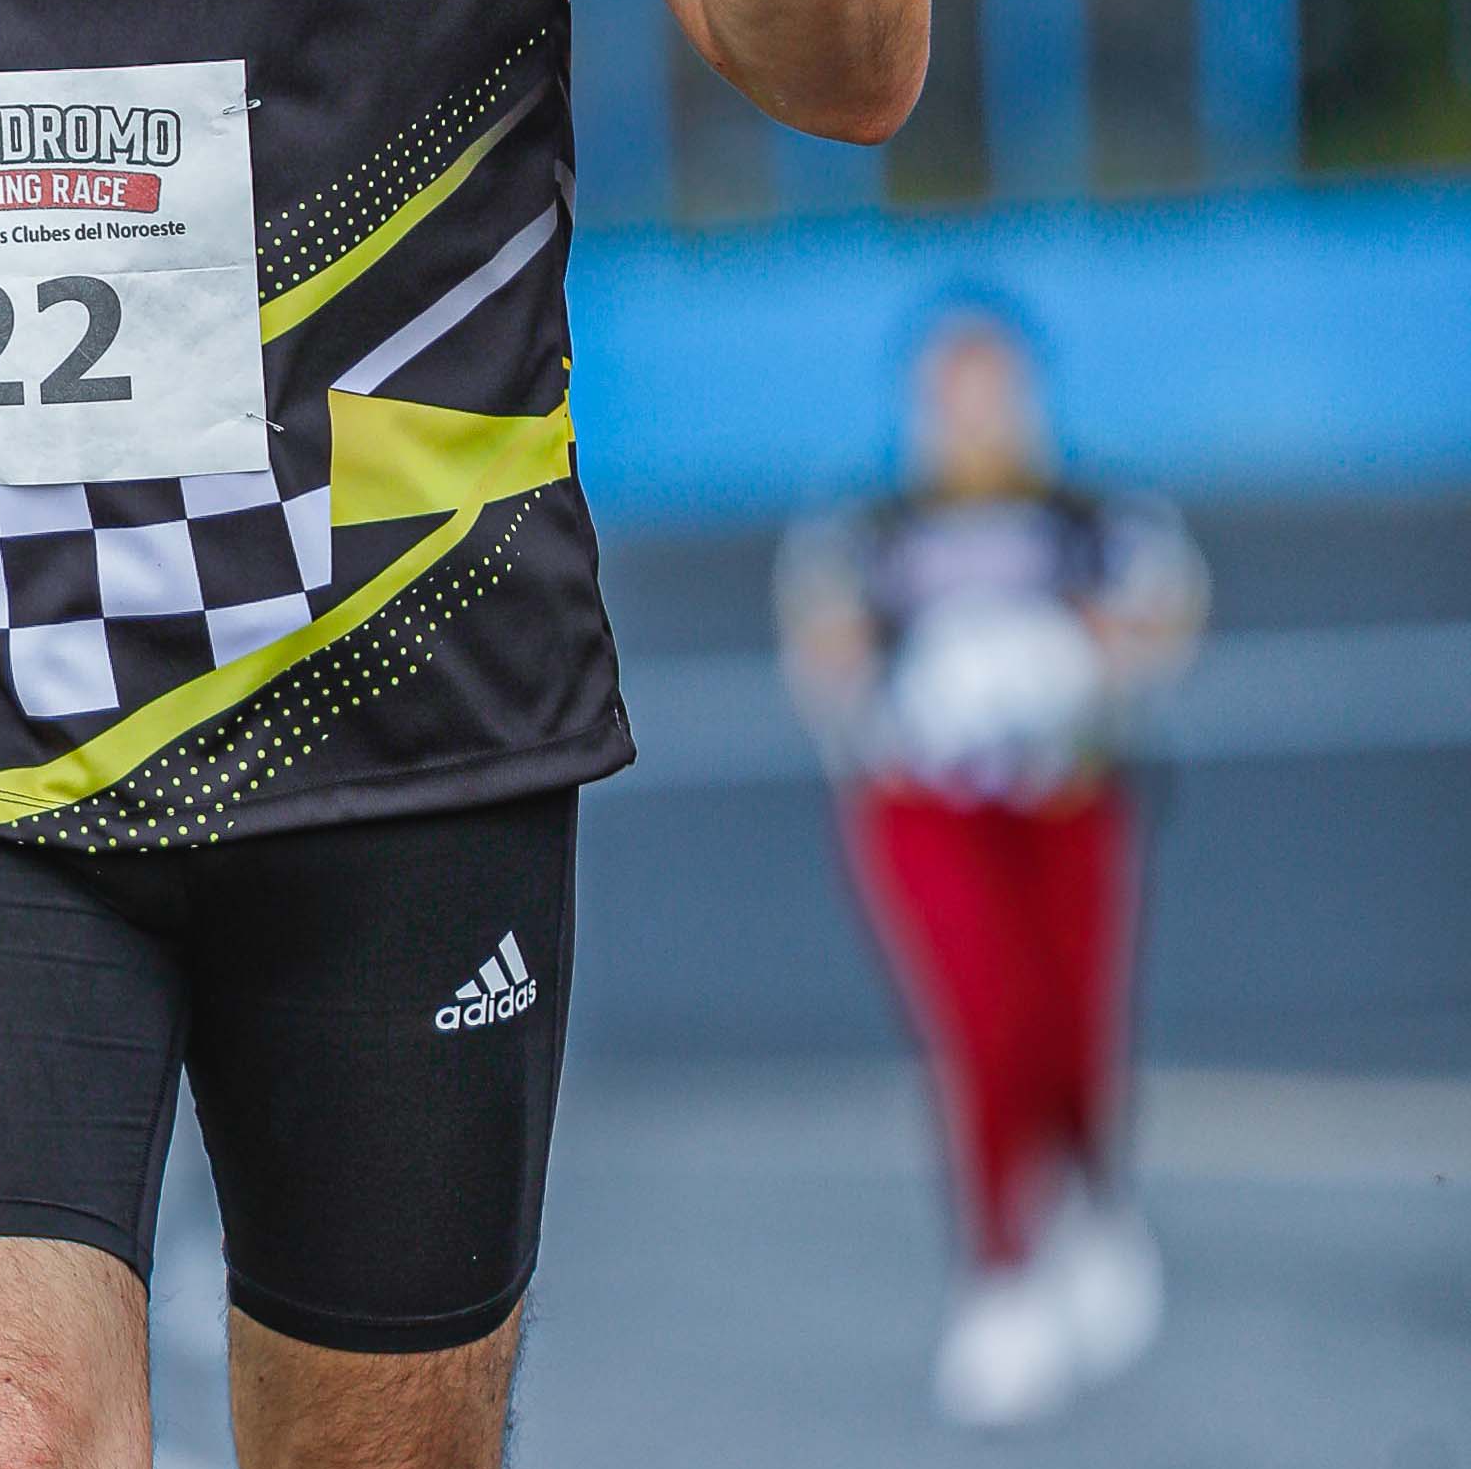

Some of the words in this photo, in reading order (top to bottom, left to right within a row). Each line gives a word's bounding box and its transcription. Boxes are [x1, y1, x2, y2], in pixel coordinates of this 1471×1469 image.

[52, 173, 128, 207] RACE
[11, 224, 71, 243] Clubes
[75, 222, 102, 240] del
[107, 220, 186, 240] Noroeste
[435, 978, 537, 1030] adidas
